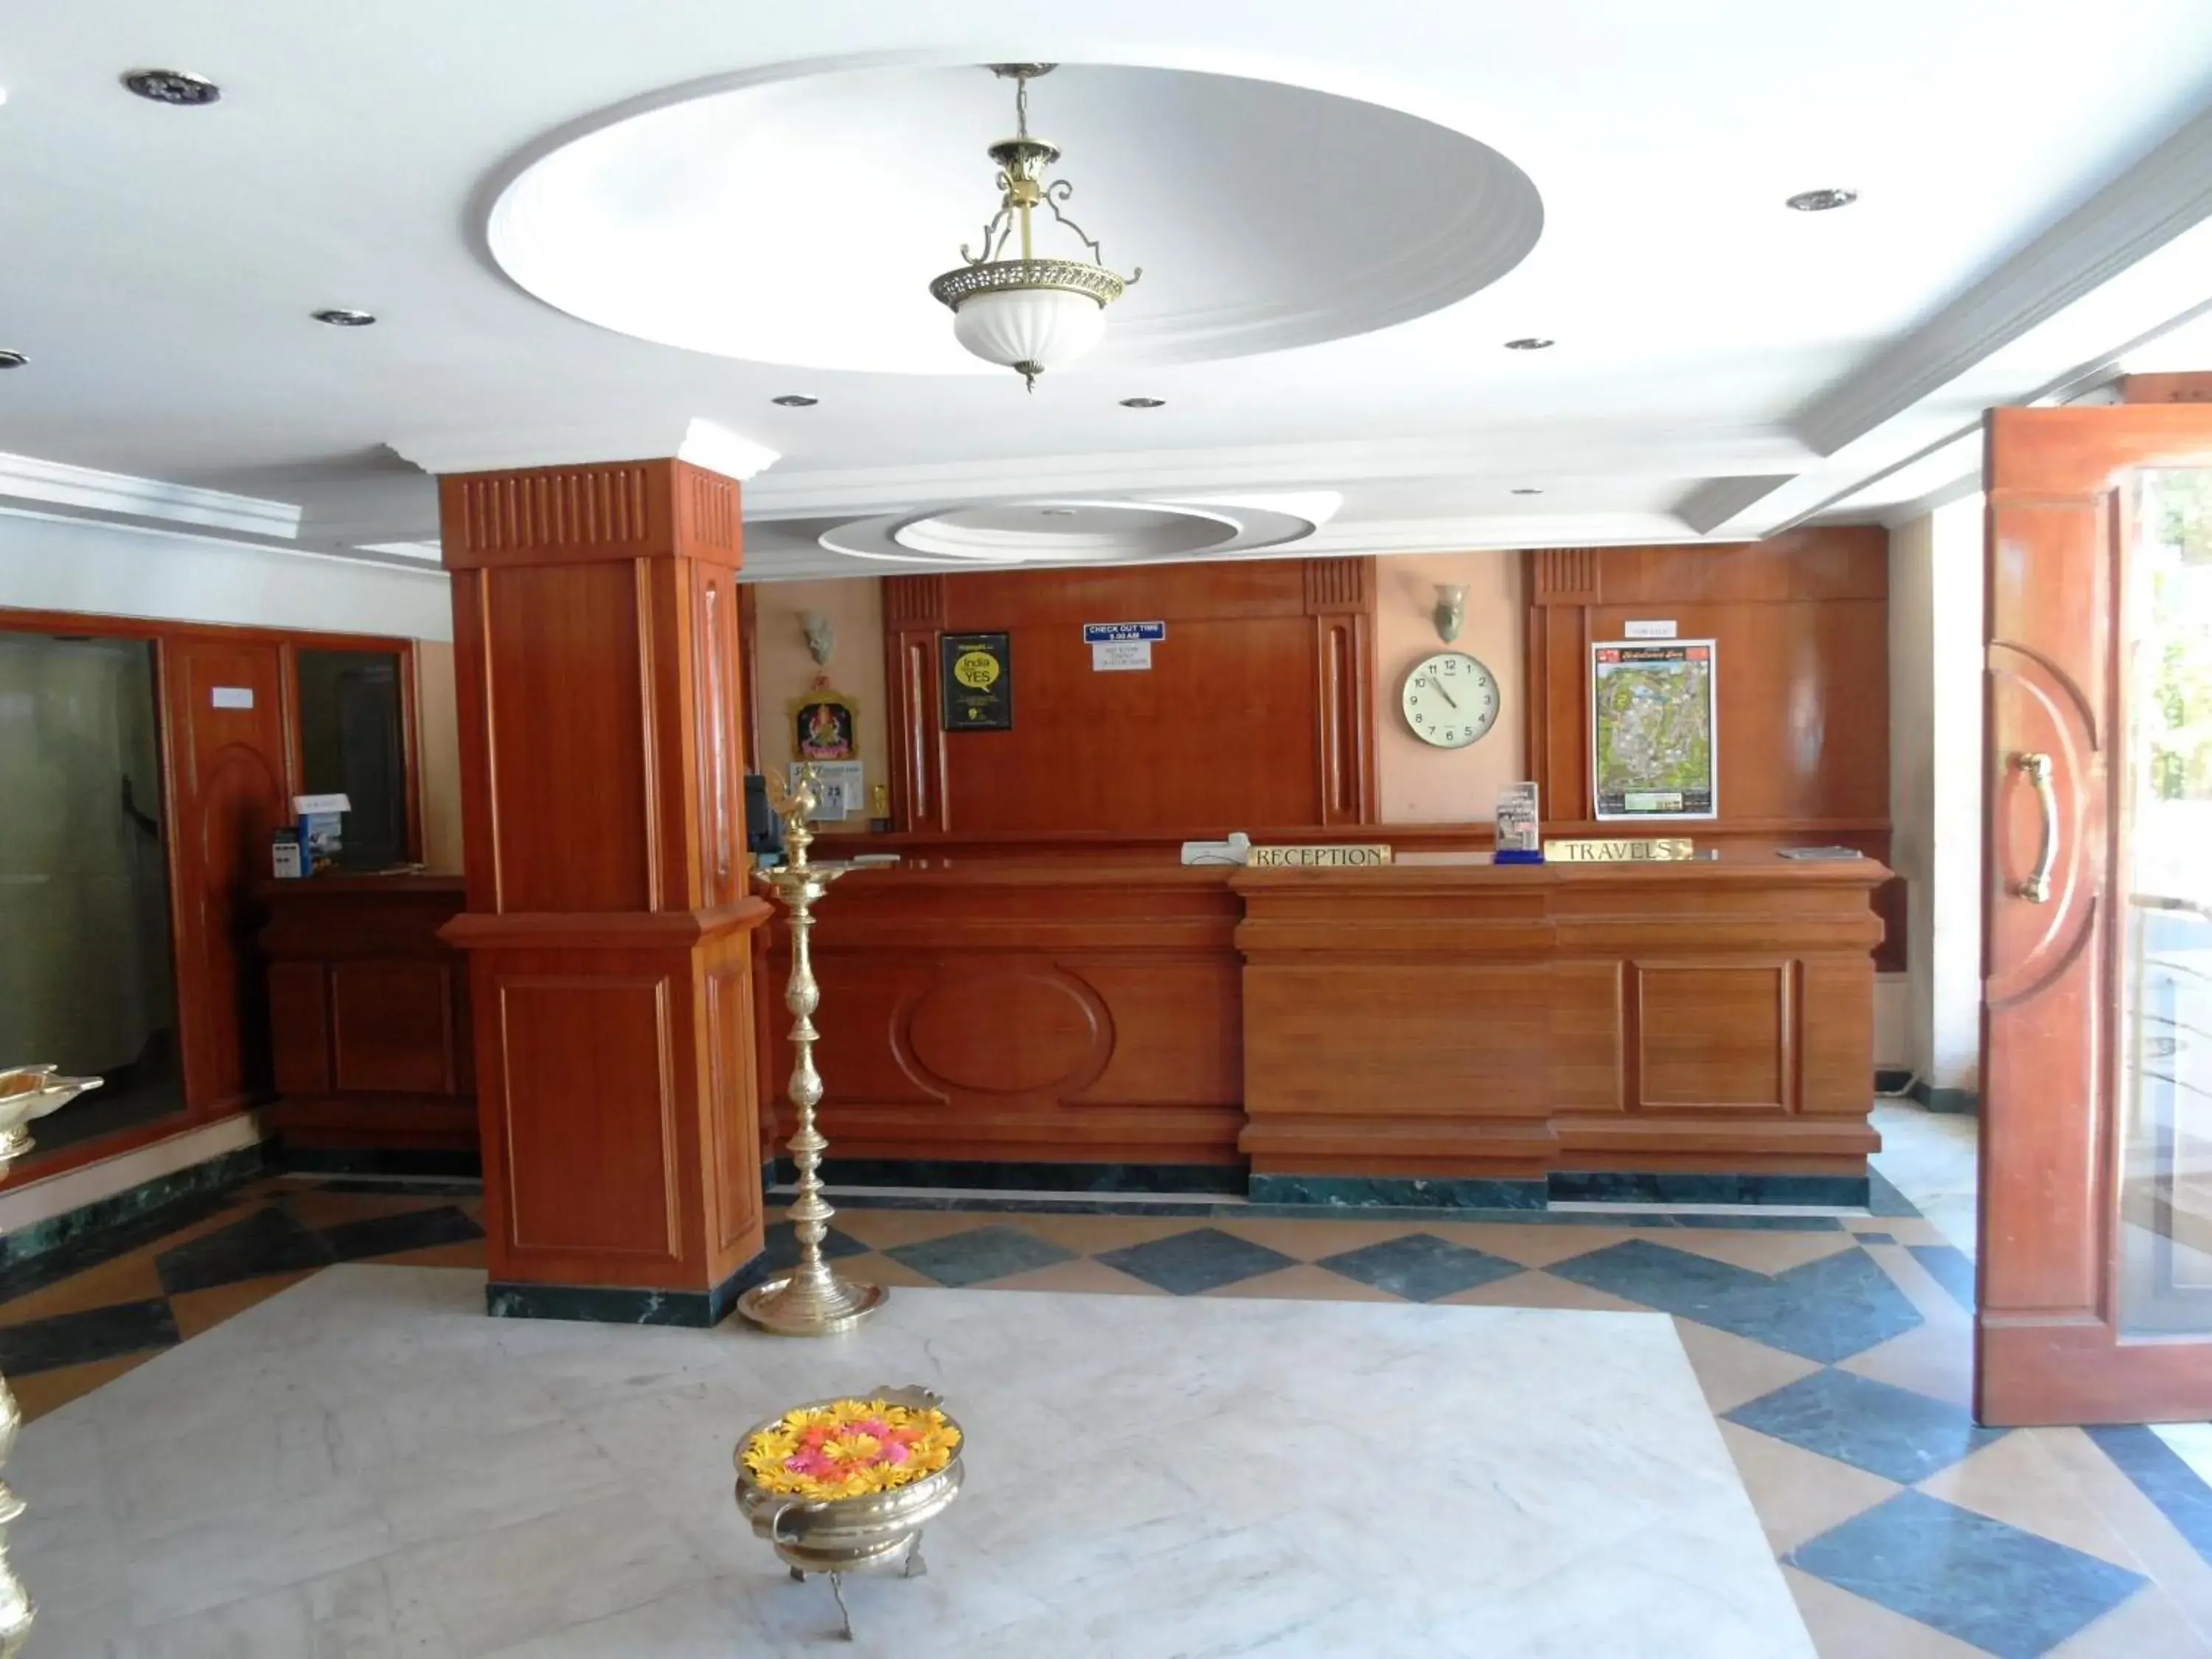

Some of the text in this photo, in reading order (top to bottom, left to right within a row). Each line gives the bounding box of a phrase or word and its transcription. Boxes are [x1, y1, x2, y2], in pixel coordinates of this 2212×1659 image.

[1089, 624, 1158, 633] CHECK OUT TIME
[964, 658, 990, 667] India
[1444, 660, 1455, 669] 12
[1429, 664, 1437, 674] 11
[1467, 664, 1472, 673] 1
[964, 670, 990, 683] YES
[1415, 678, 1425, 688] 10
[1478, 677, 1486, 687] 2
[1410, 695, 1418, 706] 9
[1484, 695, 1491, 706] 3
[1415, 713, 1423, 723] 8
[1478, 713, 1486, 723] 4
[1427, 726, 1436, 735] 7
[1464, 726, 1472, 737] 5
[1446, 731, 1453, 741] 6
[1564, 841, 1672, 861] TRAVELS
[1256, 848, 1382, 866] RECEPTION
